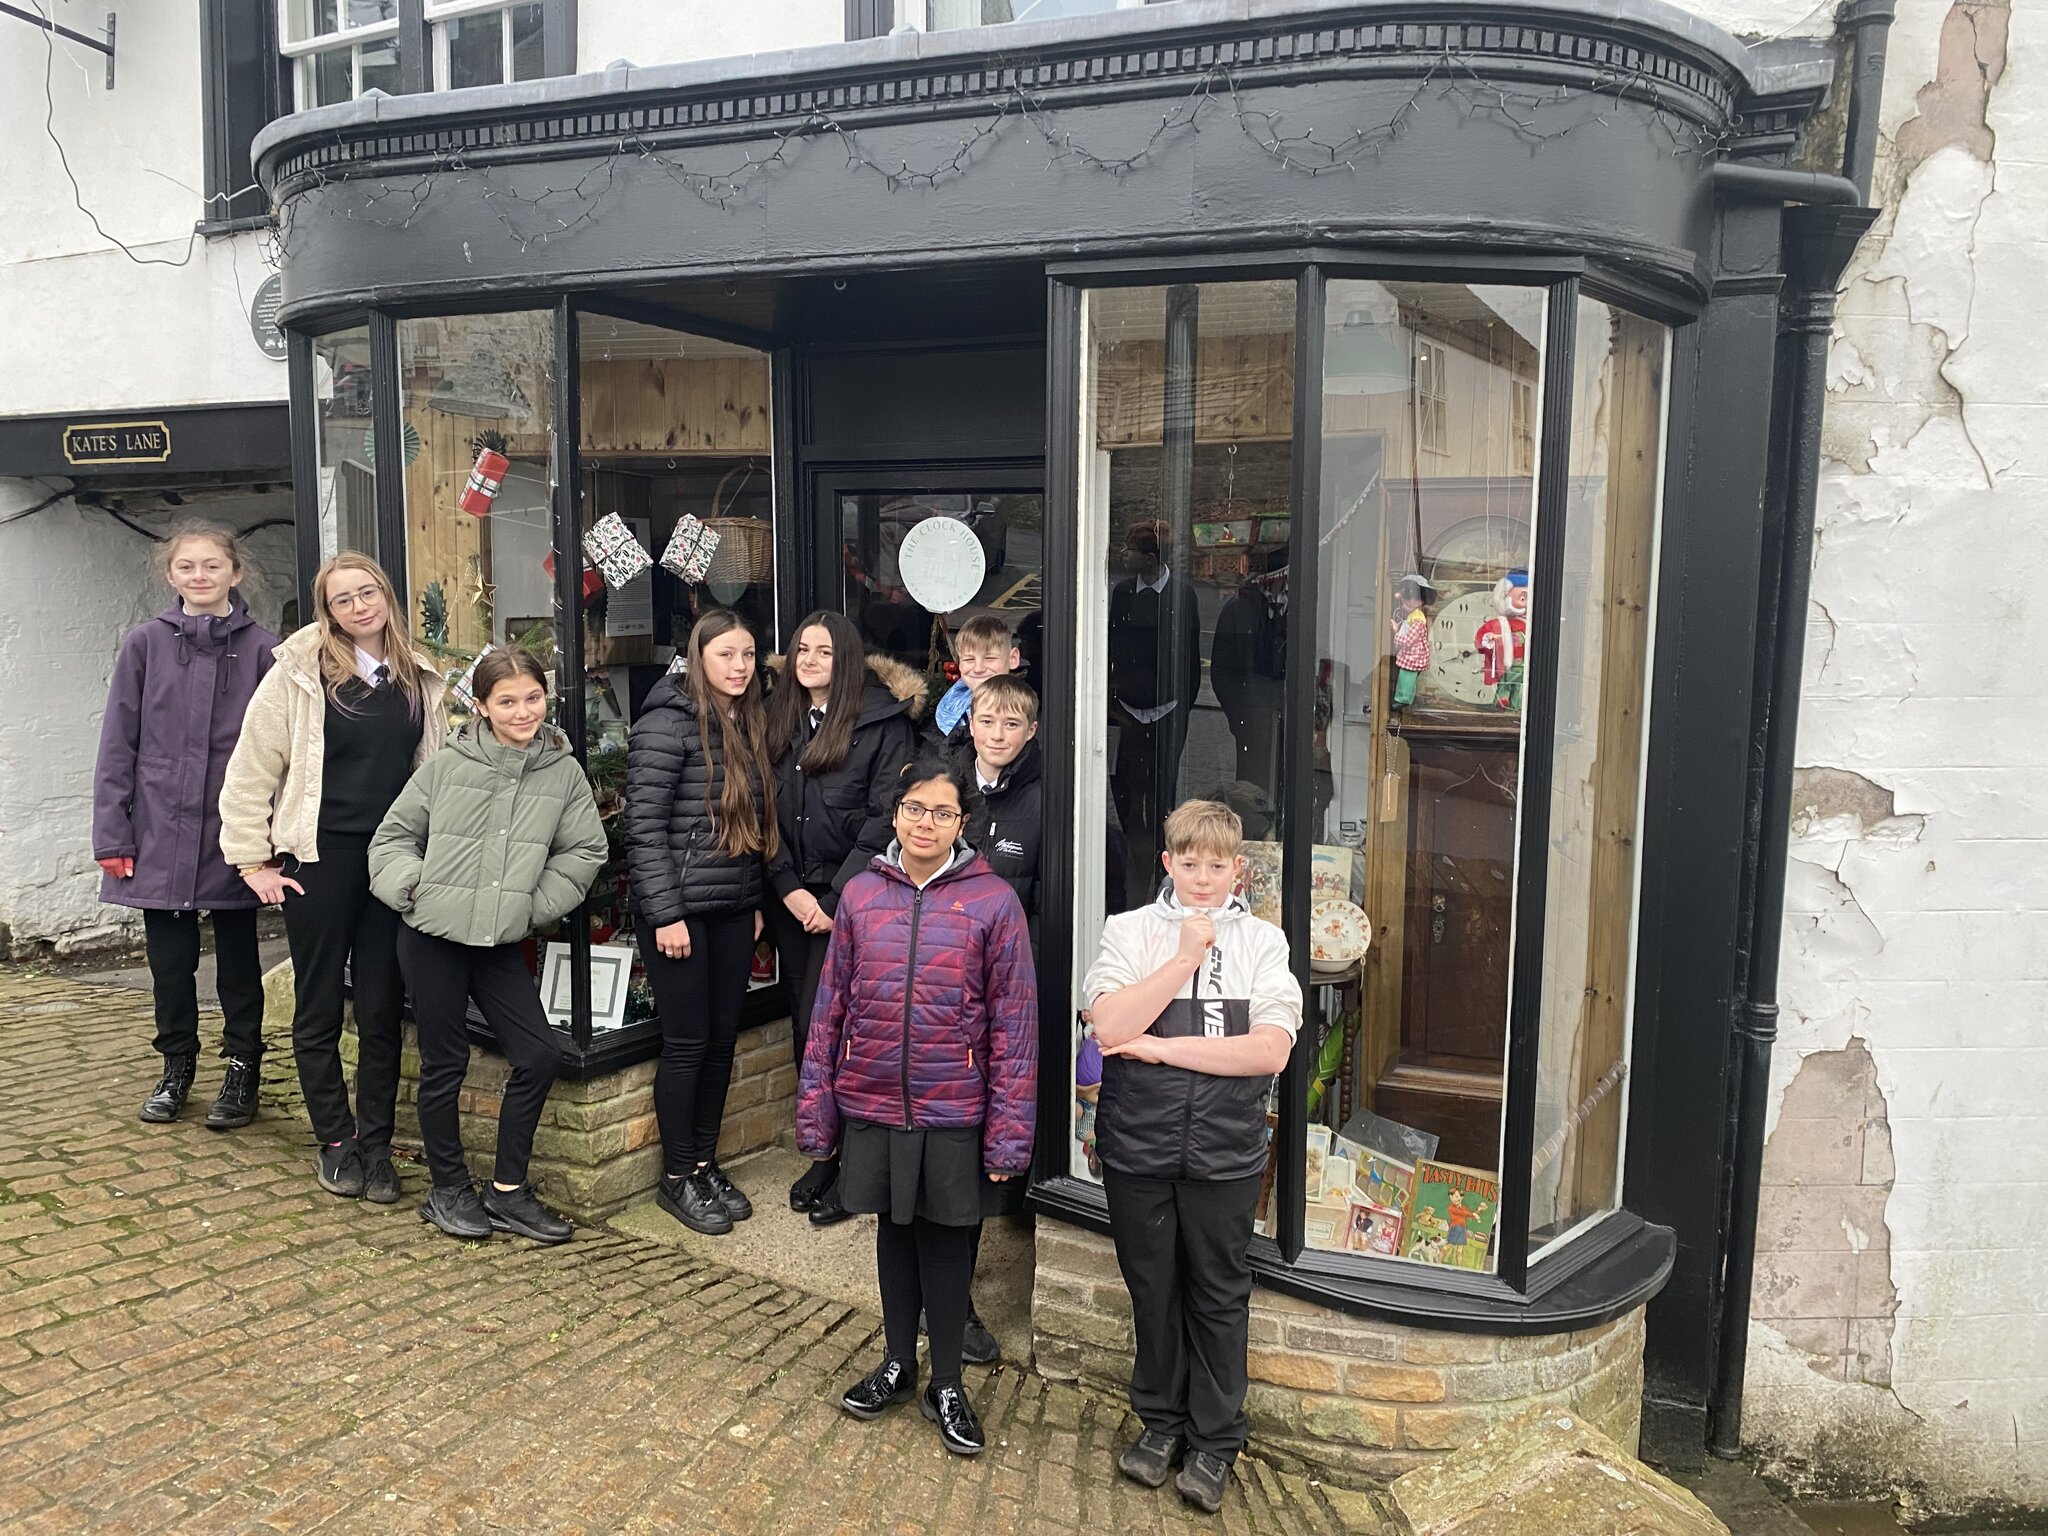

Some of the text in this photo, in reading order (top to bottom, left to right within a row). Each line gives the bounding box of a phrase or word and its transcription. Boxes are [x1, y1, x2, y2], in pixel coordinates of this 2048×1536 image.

[72, 433, 160, 452] KATE'S LANE
[905, 520, 981, 571] THE CLOCK HOUSE
[1423, 1163, 1498, 1203] TASTY BITS
